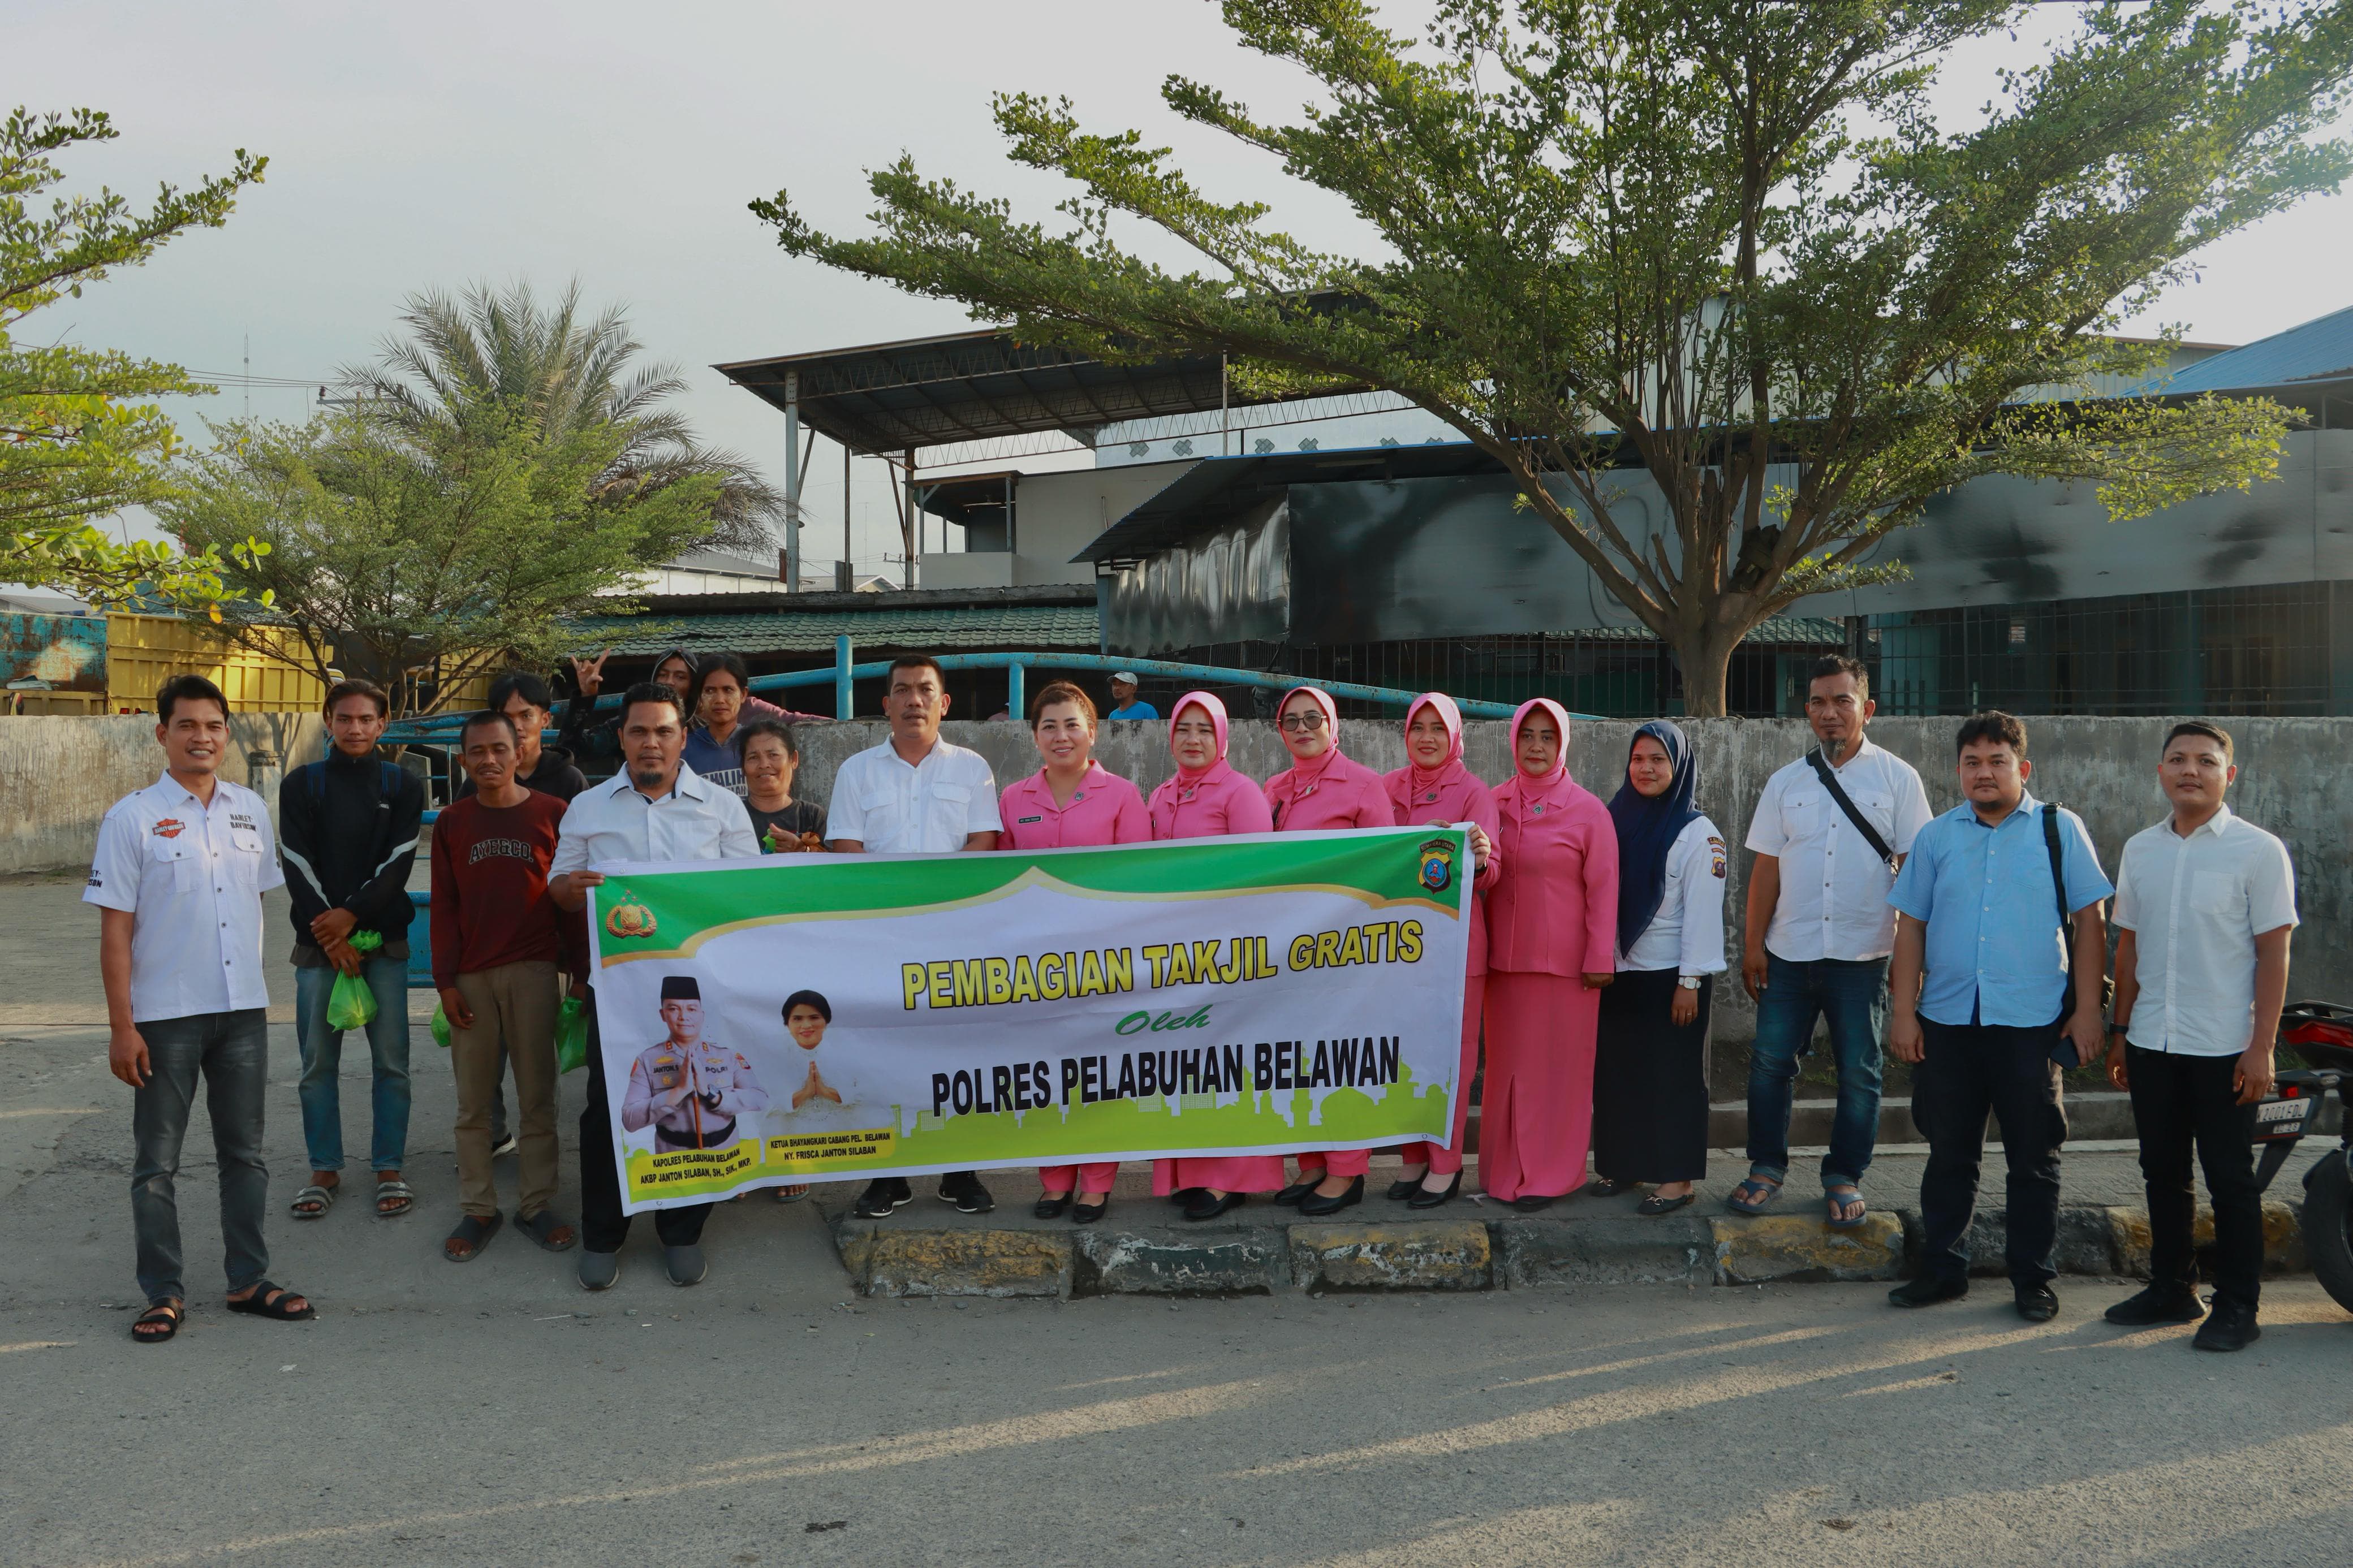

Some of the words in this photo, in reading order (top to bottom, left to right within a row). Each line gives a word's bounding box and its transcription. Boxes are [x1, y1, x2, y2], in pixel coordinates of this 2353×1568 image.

[469, 838, 533, 864] AYE&CO.
[1442, 842, 1454, 850] UTARA
[902, 947, 1134, 1010] PEMBAGIAN
[1143, 936, 1278, 988] TAKJIL
[1288, 920, 1423, 971] GRATIS
[1115, 1004, 1213, 1035] Oleh
[932, 1060, 1051, 1117] POLRES
[1061, 1044, 1243, 1106] PELABUHAN
[1254, 1036, 1399, 1091] BELAWAN
[2263, 1106, 2285, 1121] 2001
[770, 1139, 788, 1148] KETUA
[790, 1137, 827, 1147] BHAYANGKARI
[828, 1135, 849, 1144] CABANG
[865, 1133, 890, 1141] BELAWAN
[653, 1156, 681, 1168] KAPOLRES
[683, 1154, 715, 1164] PELABUHAN
[717, 1148, 740, 1163] BELAWAN
[796, 1150, 819, 1160] FRISCA
[821, 1148, 846, 1157] JANTON
[848, 1146, 876, 1155] SILABAN
[641, 1174, 656, 1184] AKBP
[658, 1171, 682, 1182] JANTON
[684, 1168, 712, 1178] SILABAN,
[738, 1157, 751, 1169] MKP.
